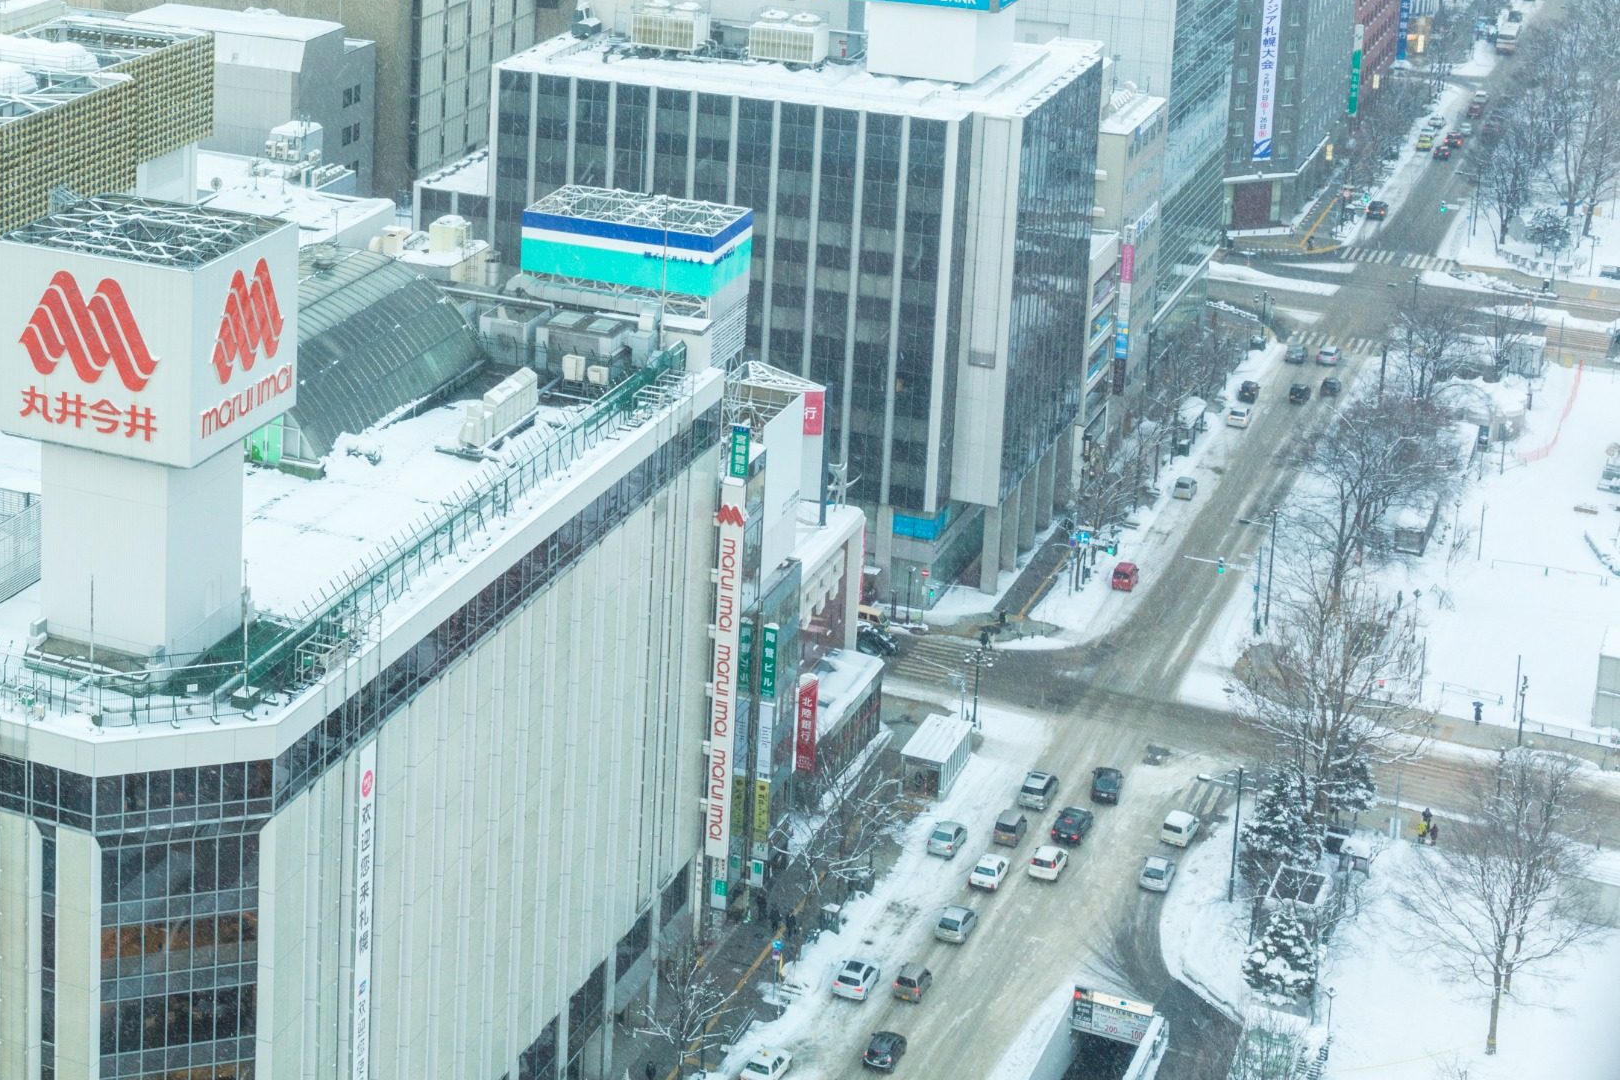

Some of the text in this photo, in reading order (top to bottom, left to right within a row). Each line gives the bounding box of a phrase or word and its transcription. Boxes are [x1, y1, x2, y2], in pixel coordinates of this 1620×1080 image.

[18, 384, 158, 442] 丸井今井
[200, 361, 293, 440] marui imai
[718, 538, 736, 633] marui imai
[713, 644, 731, 738] marui imai
[710, 748, 726, 801] marui
[708, 804, 724, 841] imai
